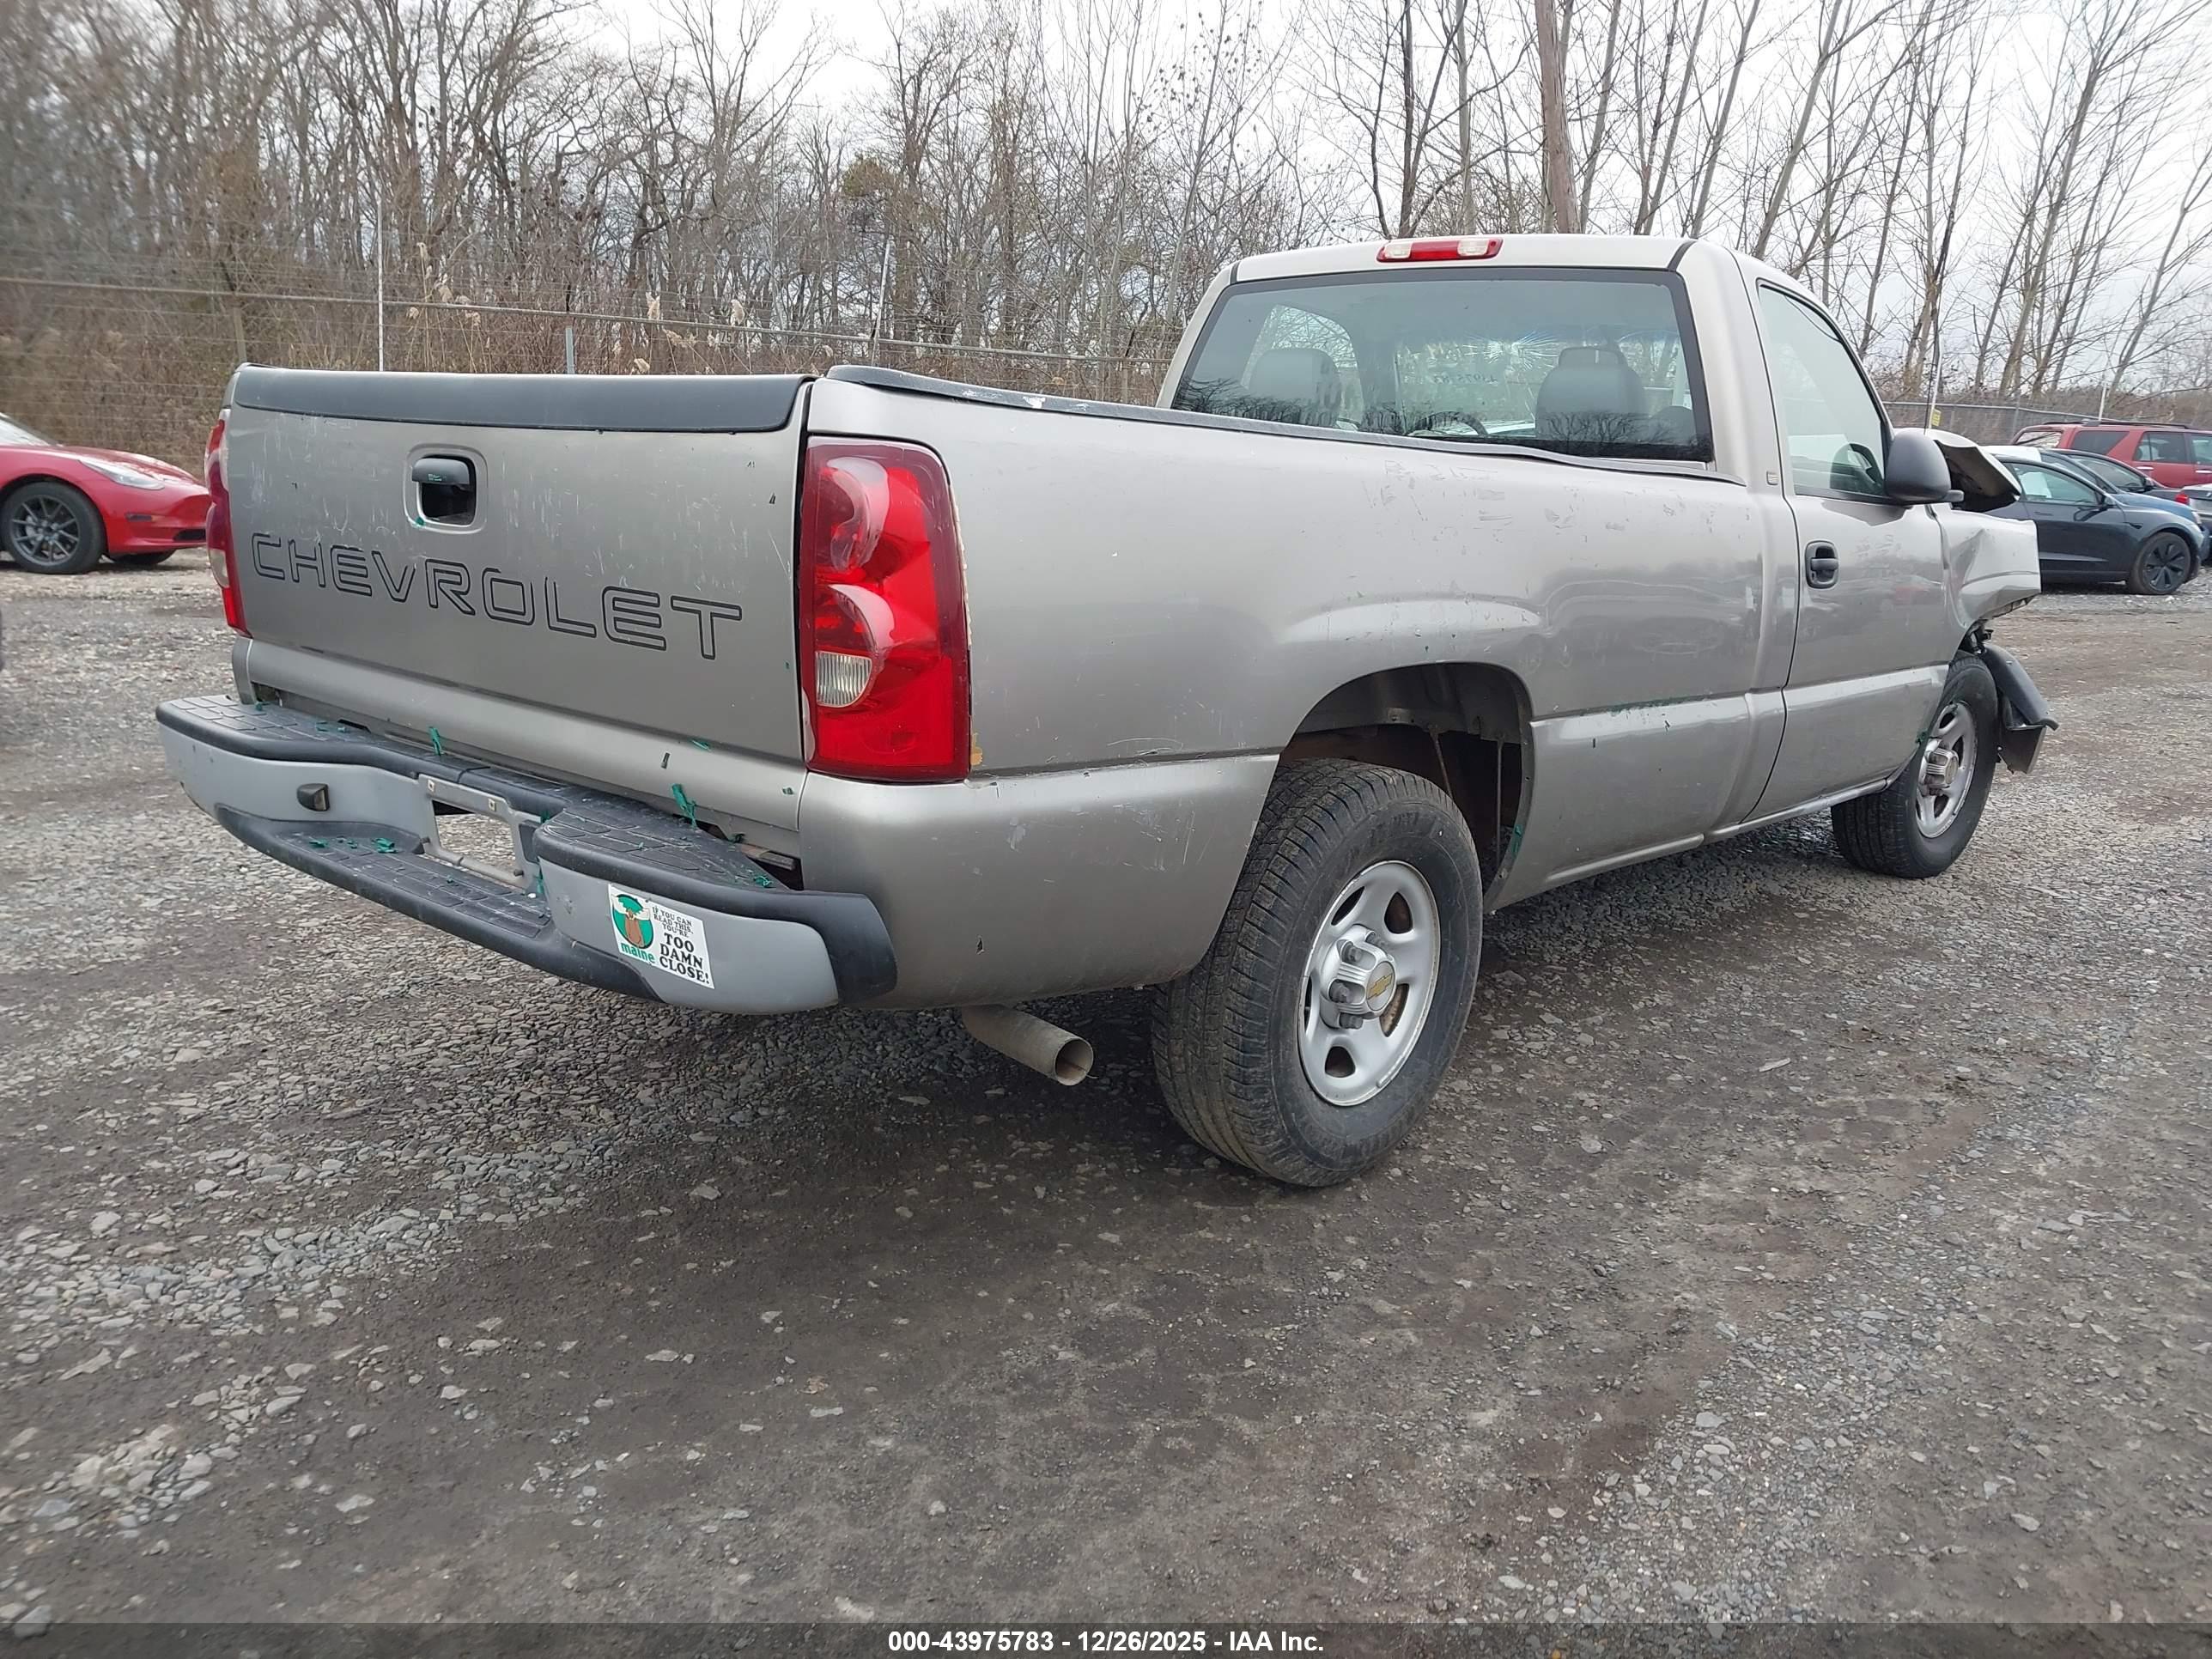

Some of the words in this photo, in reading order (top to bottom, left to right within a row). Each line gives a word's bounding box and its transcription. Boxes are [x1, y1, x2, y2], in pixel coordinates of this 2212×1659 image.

[252, 533, 743, 659] CHEVROLET
[653, 914, 672, 926] READ
[660, 909, 675, 921] YOU
[677, 916, 692, 927] CAN
[621, 942, 655, 963] maine
[664, 933, 694, 952] TOO
[660, 943, 702, 969] DAMN
[659, 956, 709, 984] CLOSE!
